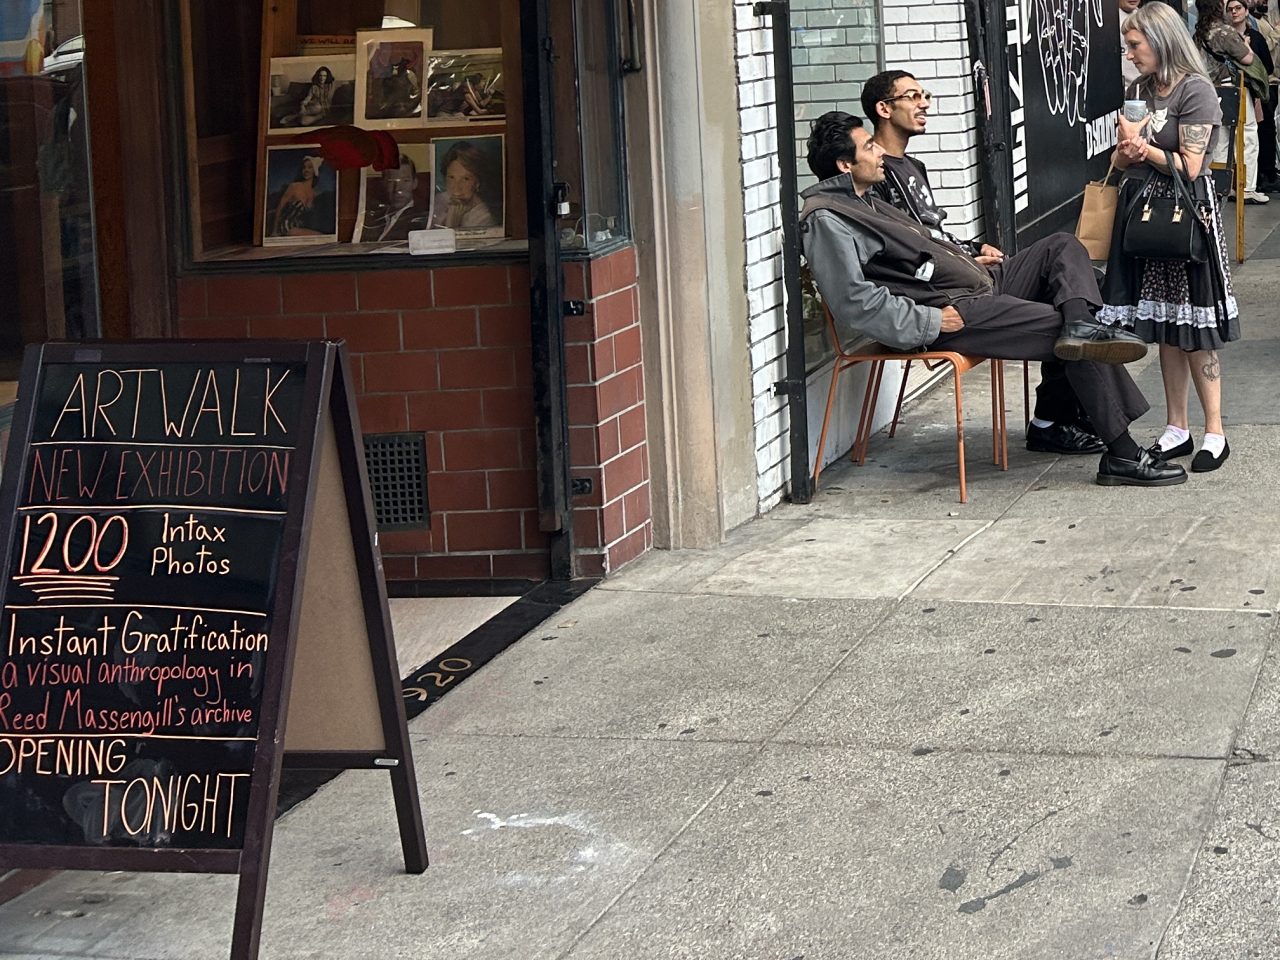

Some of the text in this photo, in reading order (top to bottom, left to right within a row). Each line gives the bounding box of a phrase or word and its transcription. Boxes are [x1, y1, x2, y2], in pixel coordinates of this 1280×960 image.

[51, 368, 290, 438] ARTWALK
[28, 449, 290, 503] NEW EXHIBITION
[18, 512, 226, 575] 1200 Intax
[151, 547, 231, 577] Photos
[8, 610, 268, 656] Instant Gratification
[2, 654, 253, 704] a visual anthropology in
[401, 657, 472, 701] 920
[0, 688, 252, 735] Reed Massengill's archive
[0, 738, 250, 837] OPENING TONIGHT
